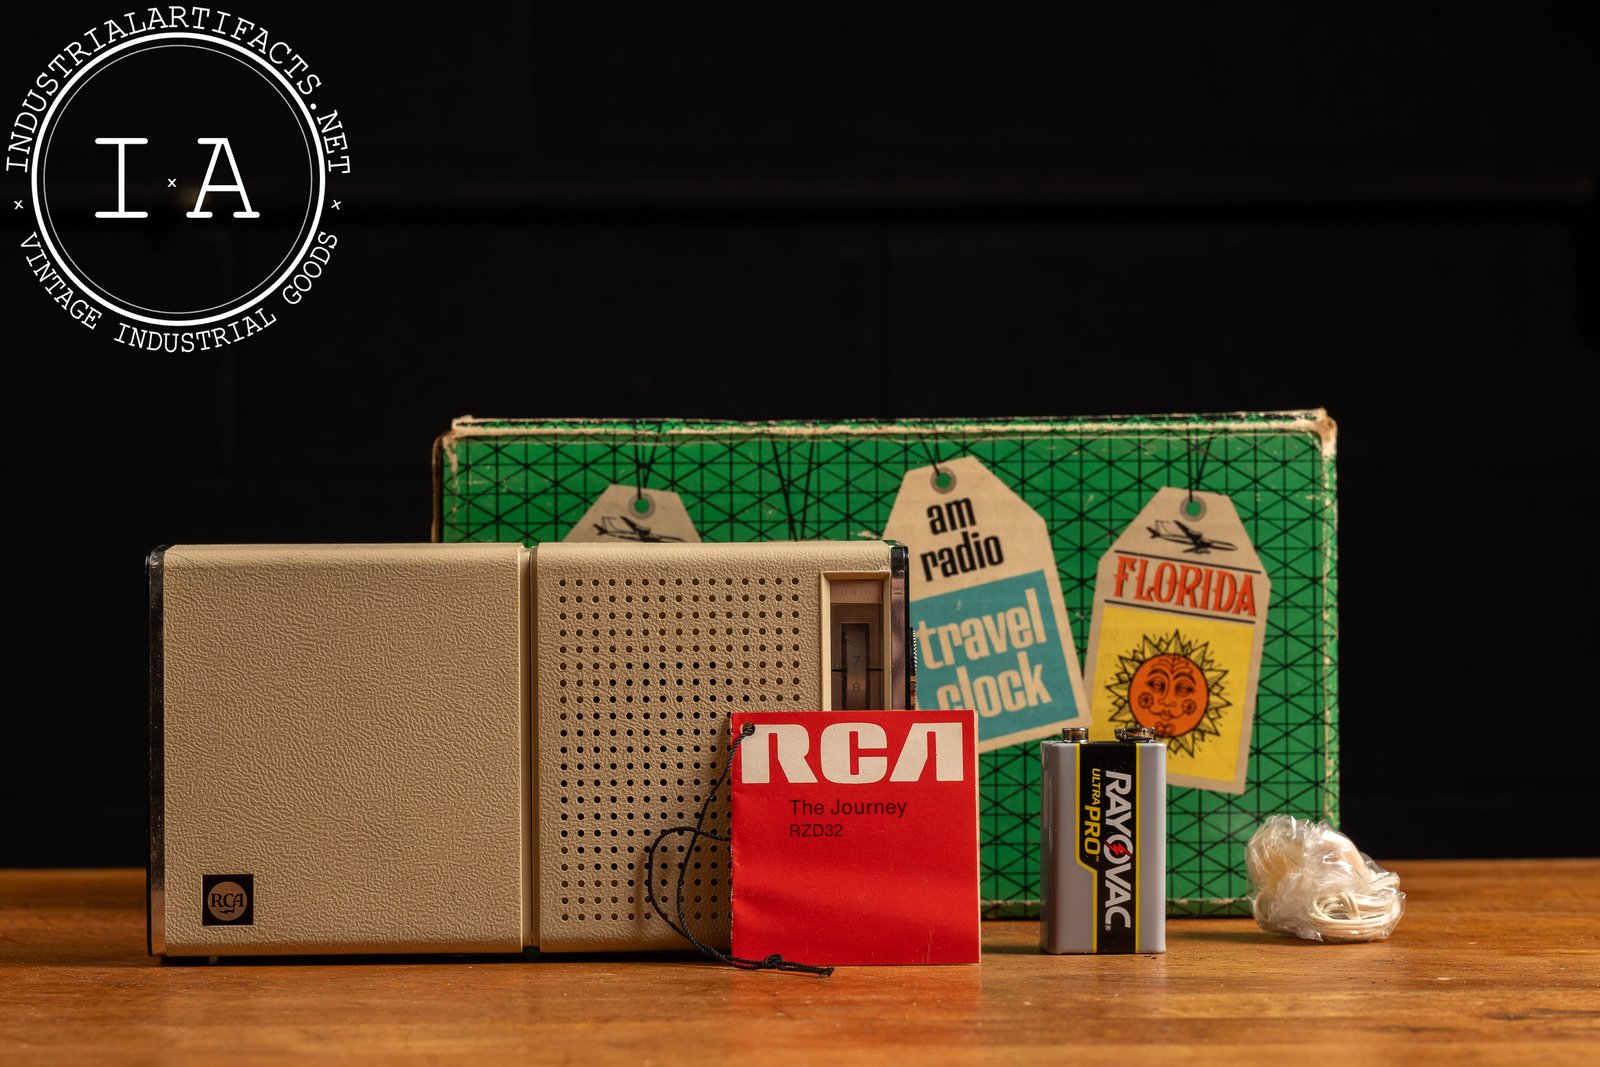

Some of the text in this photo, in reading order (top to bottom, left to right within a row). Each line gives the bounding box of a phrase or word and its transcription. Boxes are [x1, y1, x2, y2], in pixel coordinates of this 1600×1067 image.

[926, 497, 977, 536] am
[920, 532, 1004, 582] radio
[1113, 555, 1257, 618] FLORIDA
[916, 587, 1047, 670] travel
[852, 655, 861, 666] 7
[936, 651, 1052, 718] clock
[740, 722, 964, 784] RCA
[789, 799, 908, 818] The Journey
[789, 824, 843, 837] RZD32
[210, 893, 244, 914] RCA
